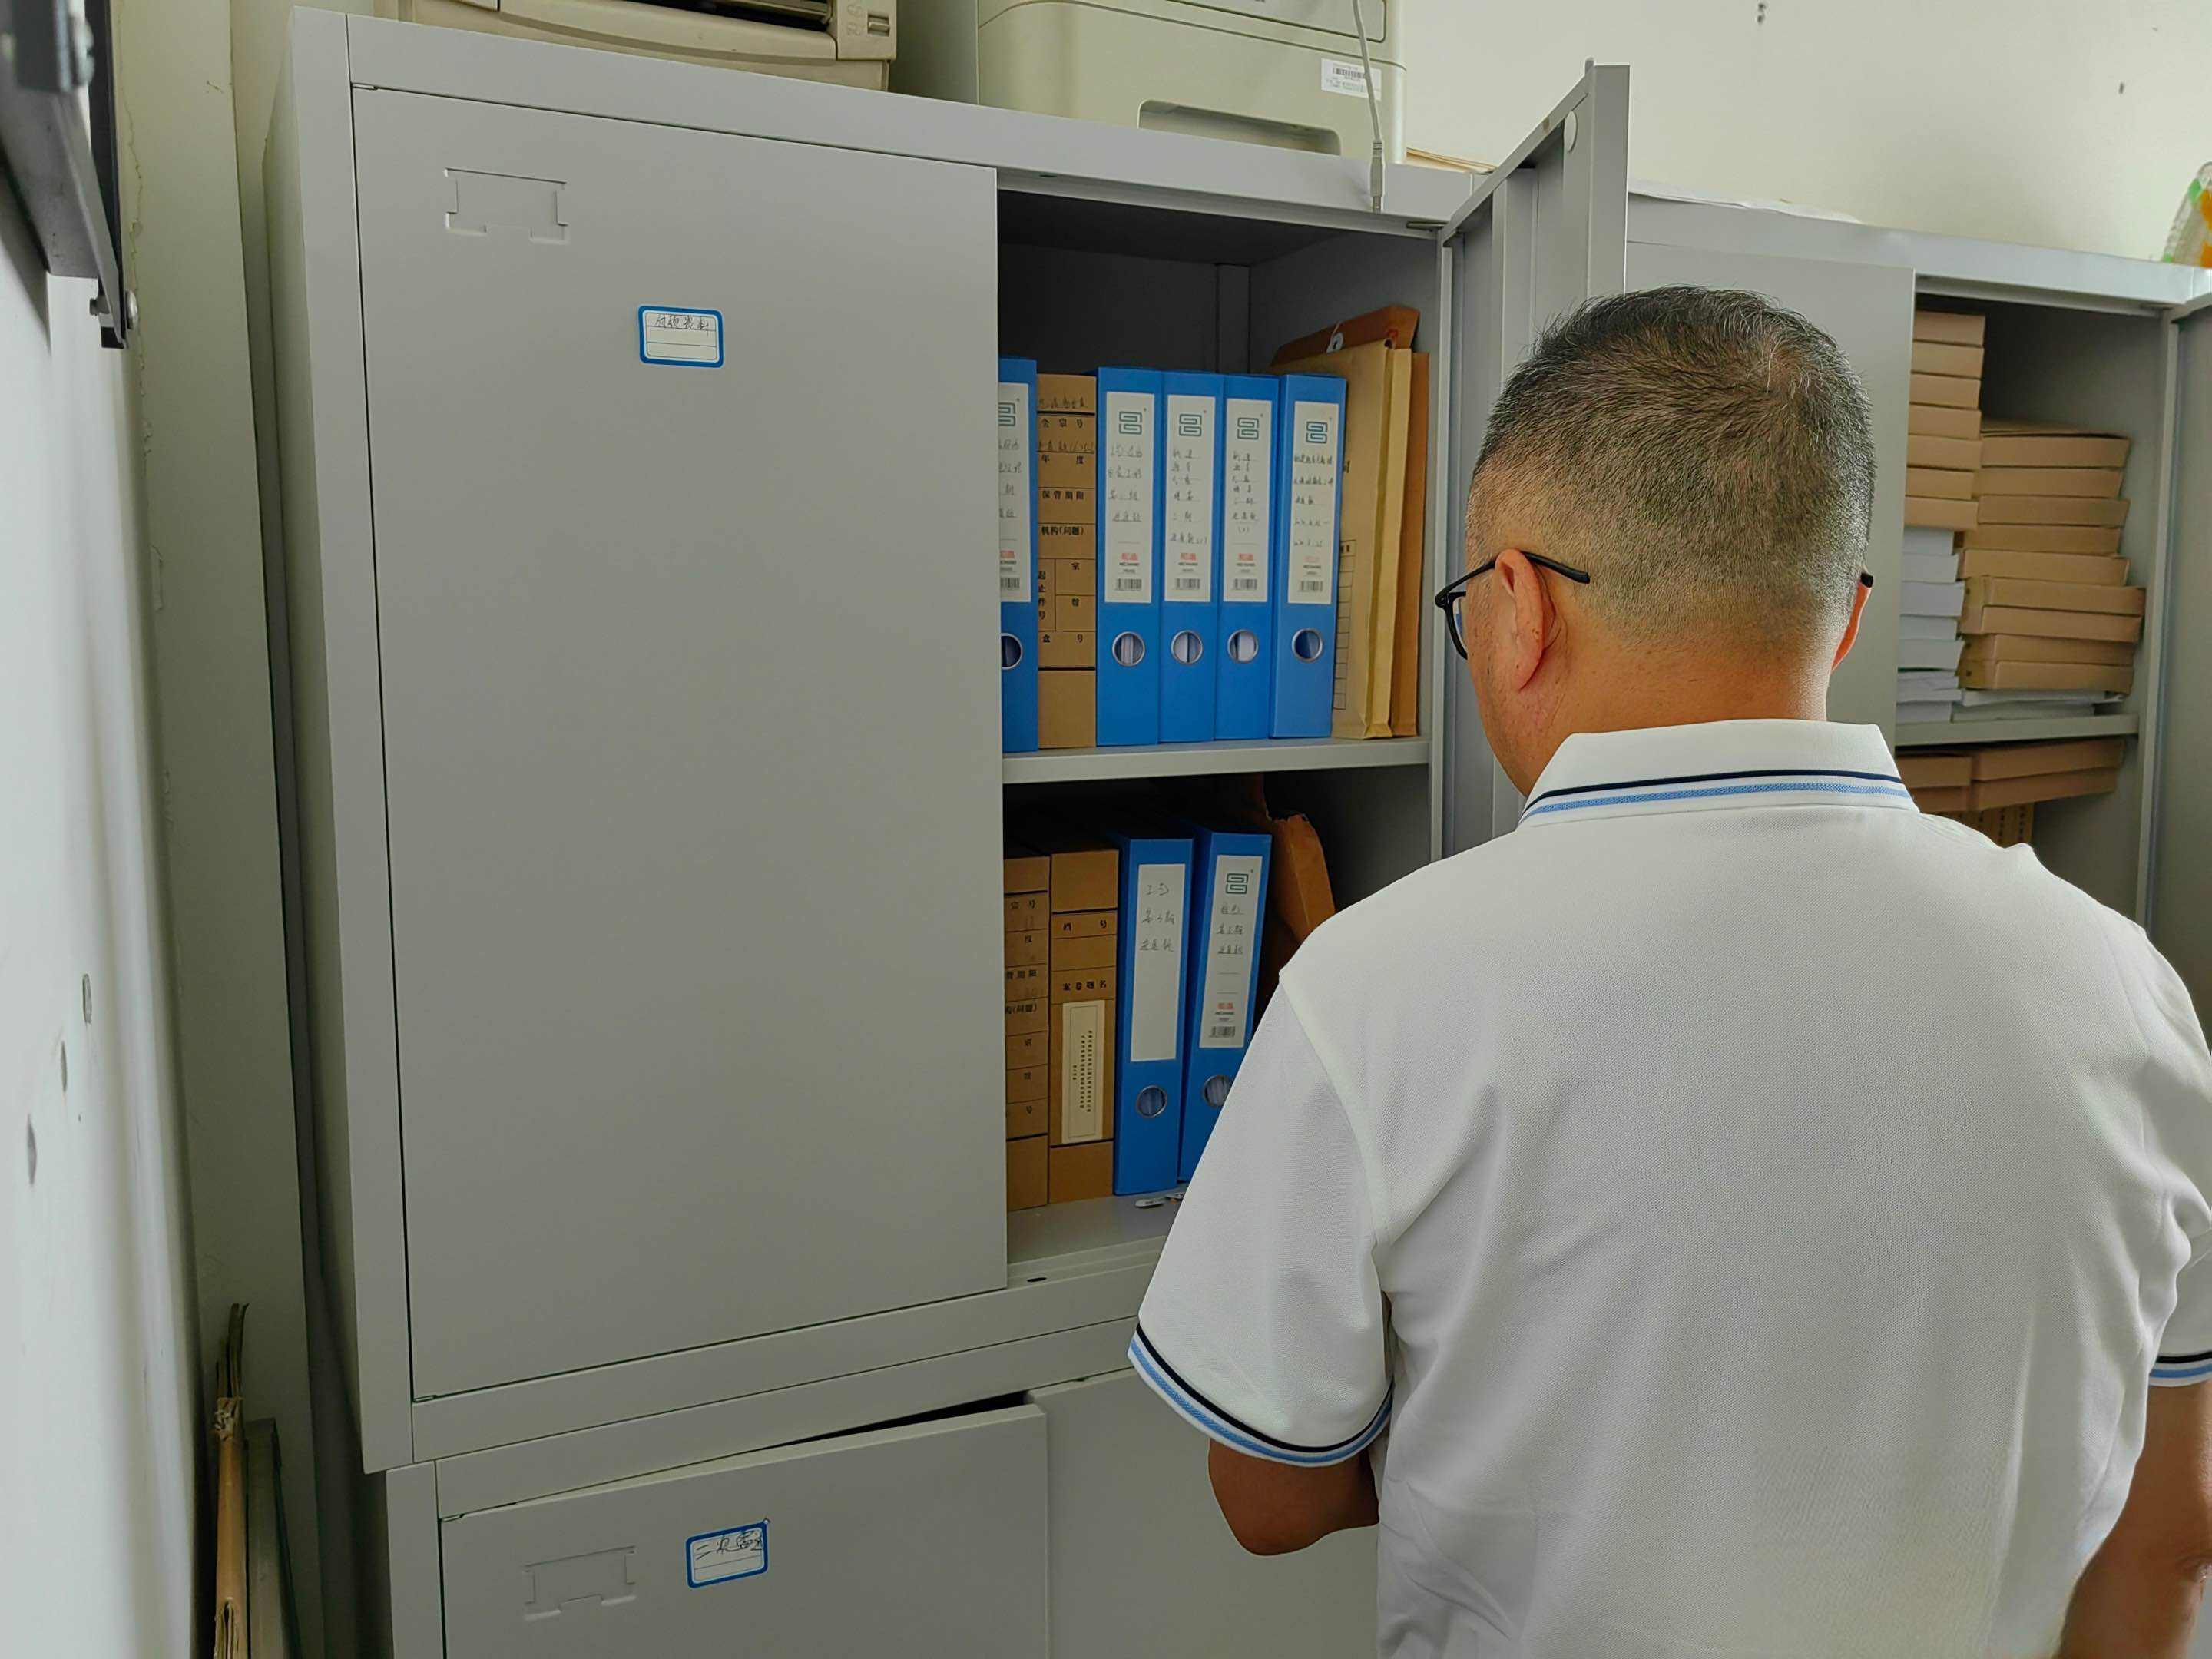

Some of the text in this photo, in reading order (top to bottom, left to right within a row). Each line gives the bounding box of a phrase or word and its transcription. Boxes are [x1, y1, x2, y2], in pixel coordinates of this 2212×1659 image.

[1041, 418, 1084, 429] 全宗号
[1041, 454, 1084, 465] 年度
[1041, 490, 1084, 500] 保管期限
[1041, 526, 1084, 536] 机构(问题)
[1042, 634, 1084, 643] 盒号
[1063, 980, 1107, 991] 案卷题名
